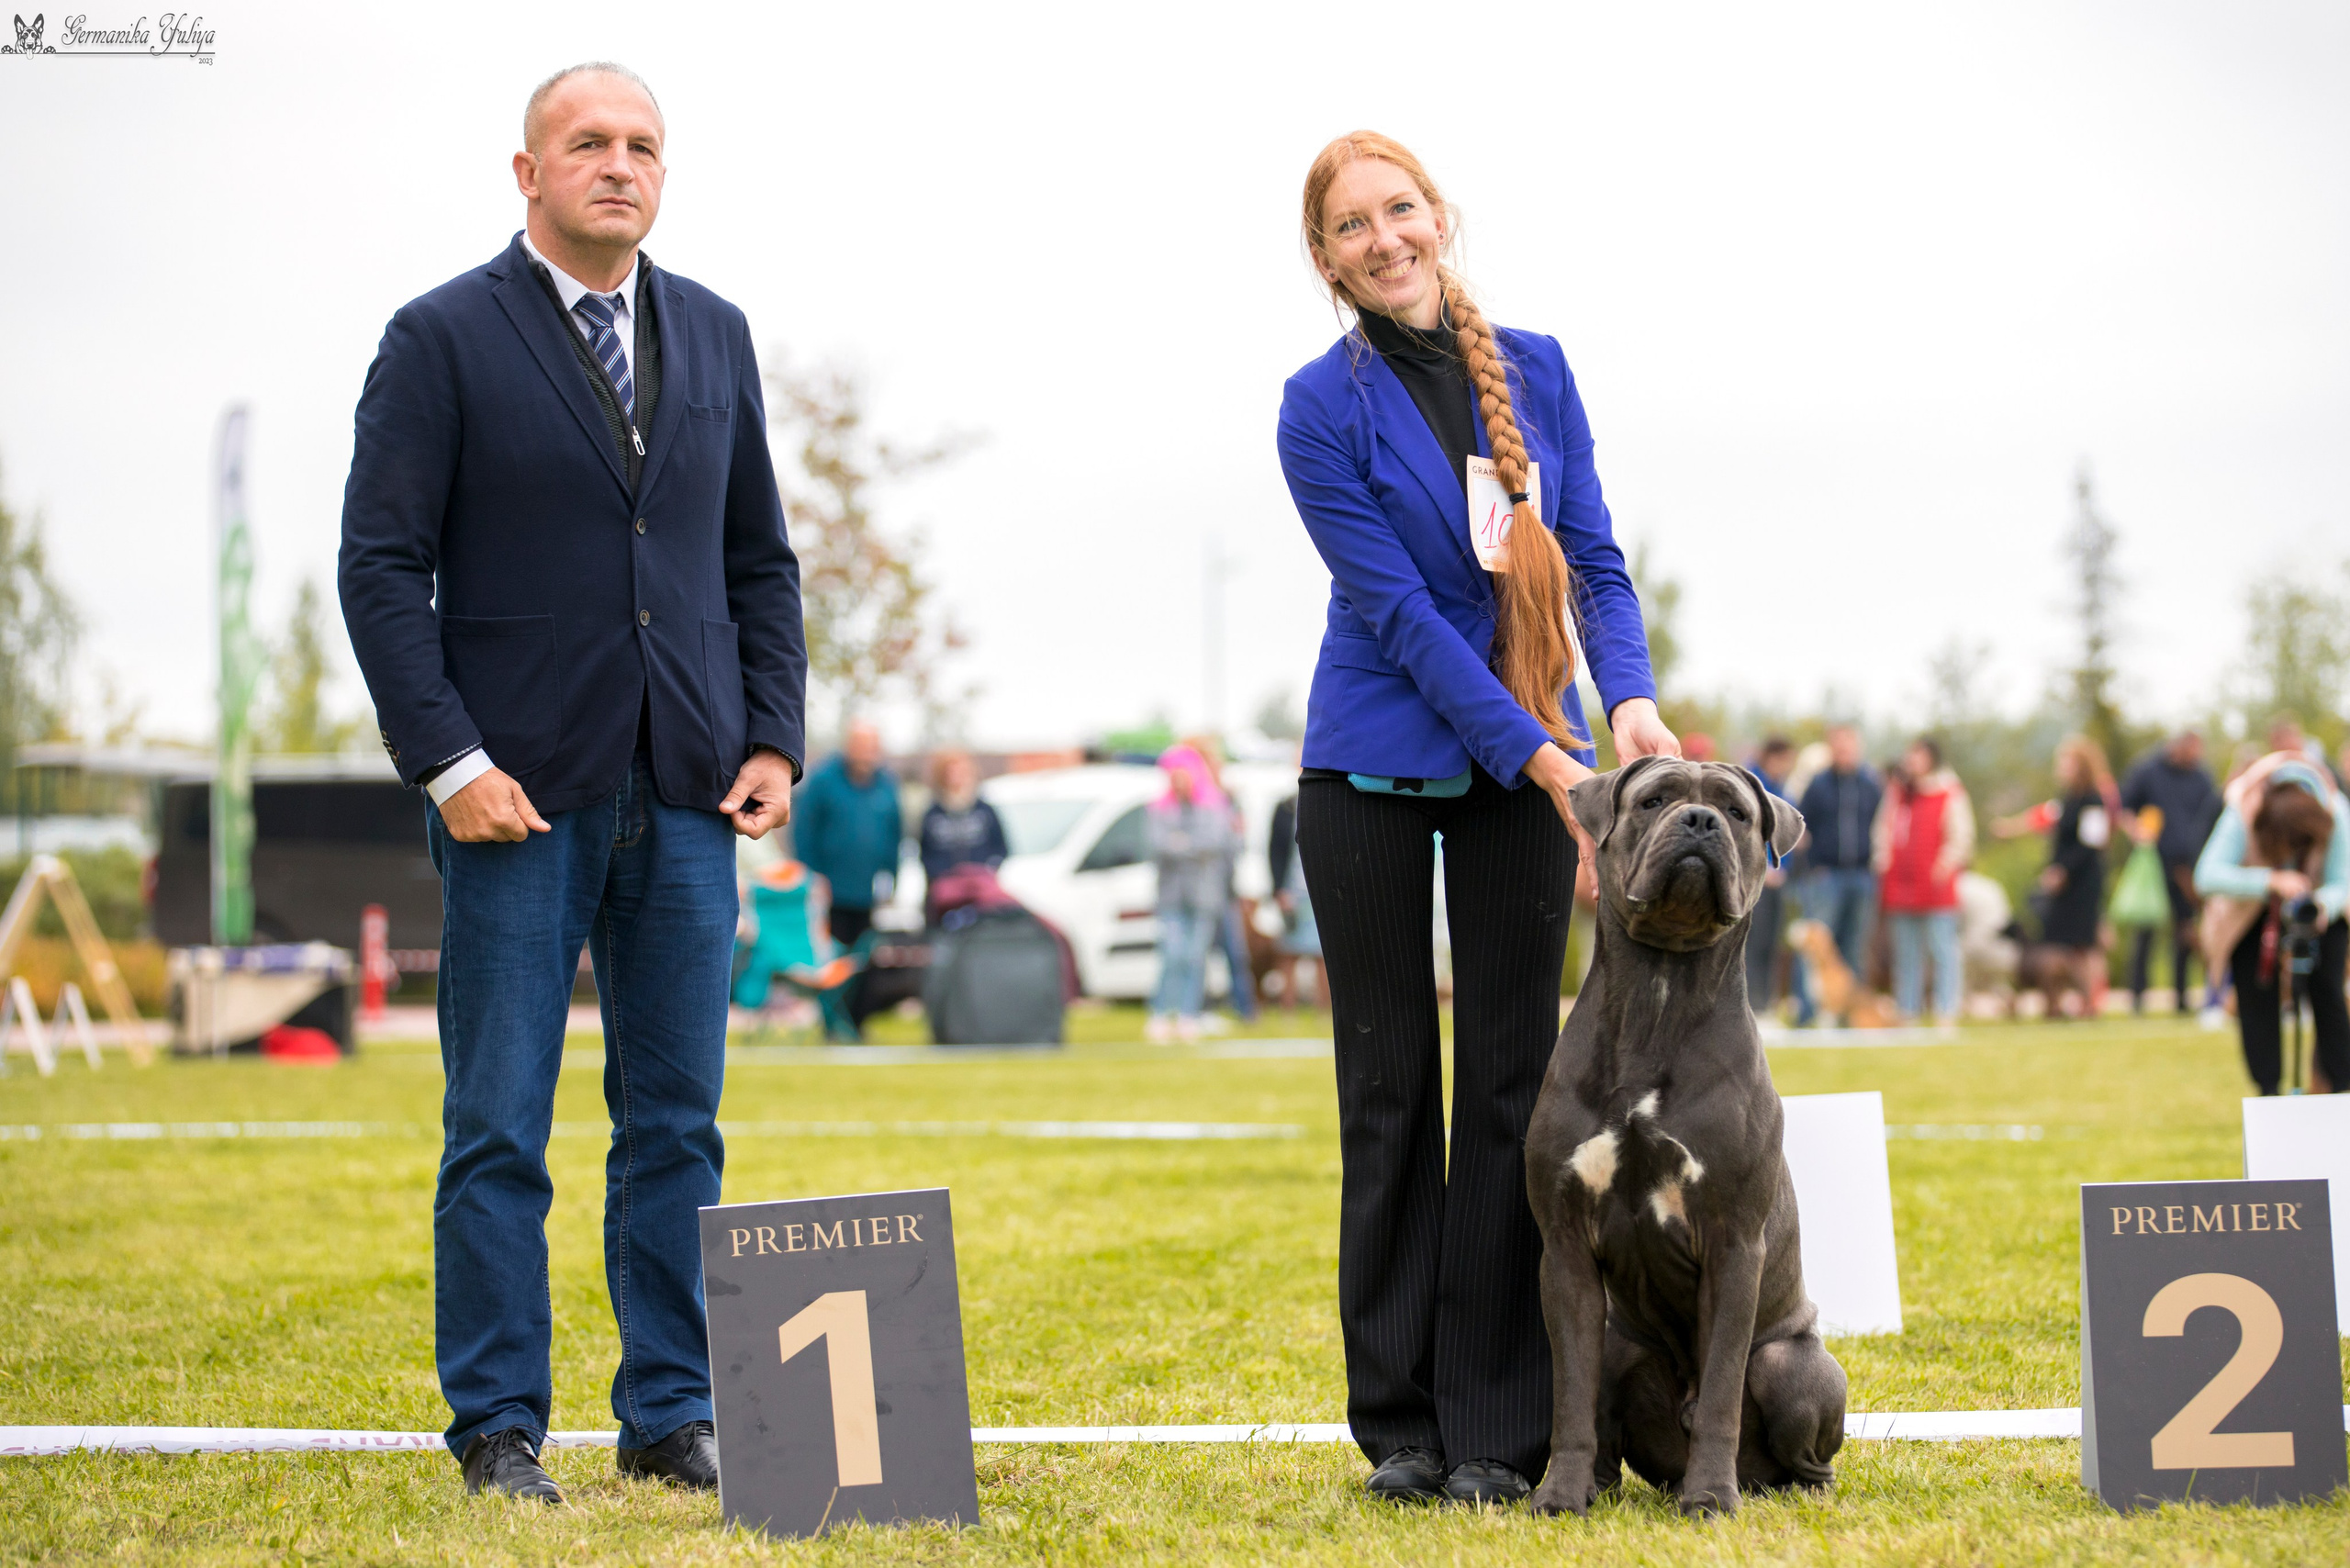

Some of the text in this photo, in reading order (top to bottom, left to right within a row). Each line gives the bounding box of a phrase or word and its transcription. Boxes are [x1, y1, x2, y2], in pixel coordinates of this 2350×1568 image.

[1472, 465, 1499, 477] GRAN
[778, 1290, 883, 1487] 1
[2142, 1272, 2295, 1470] 2
